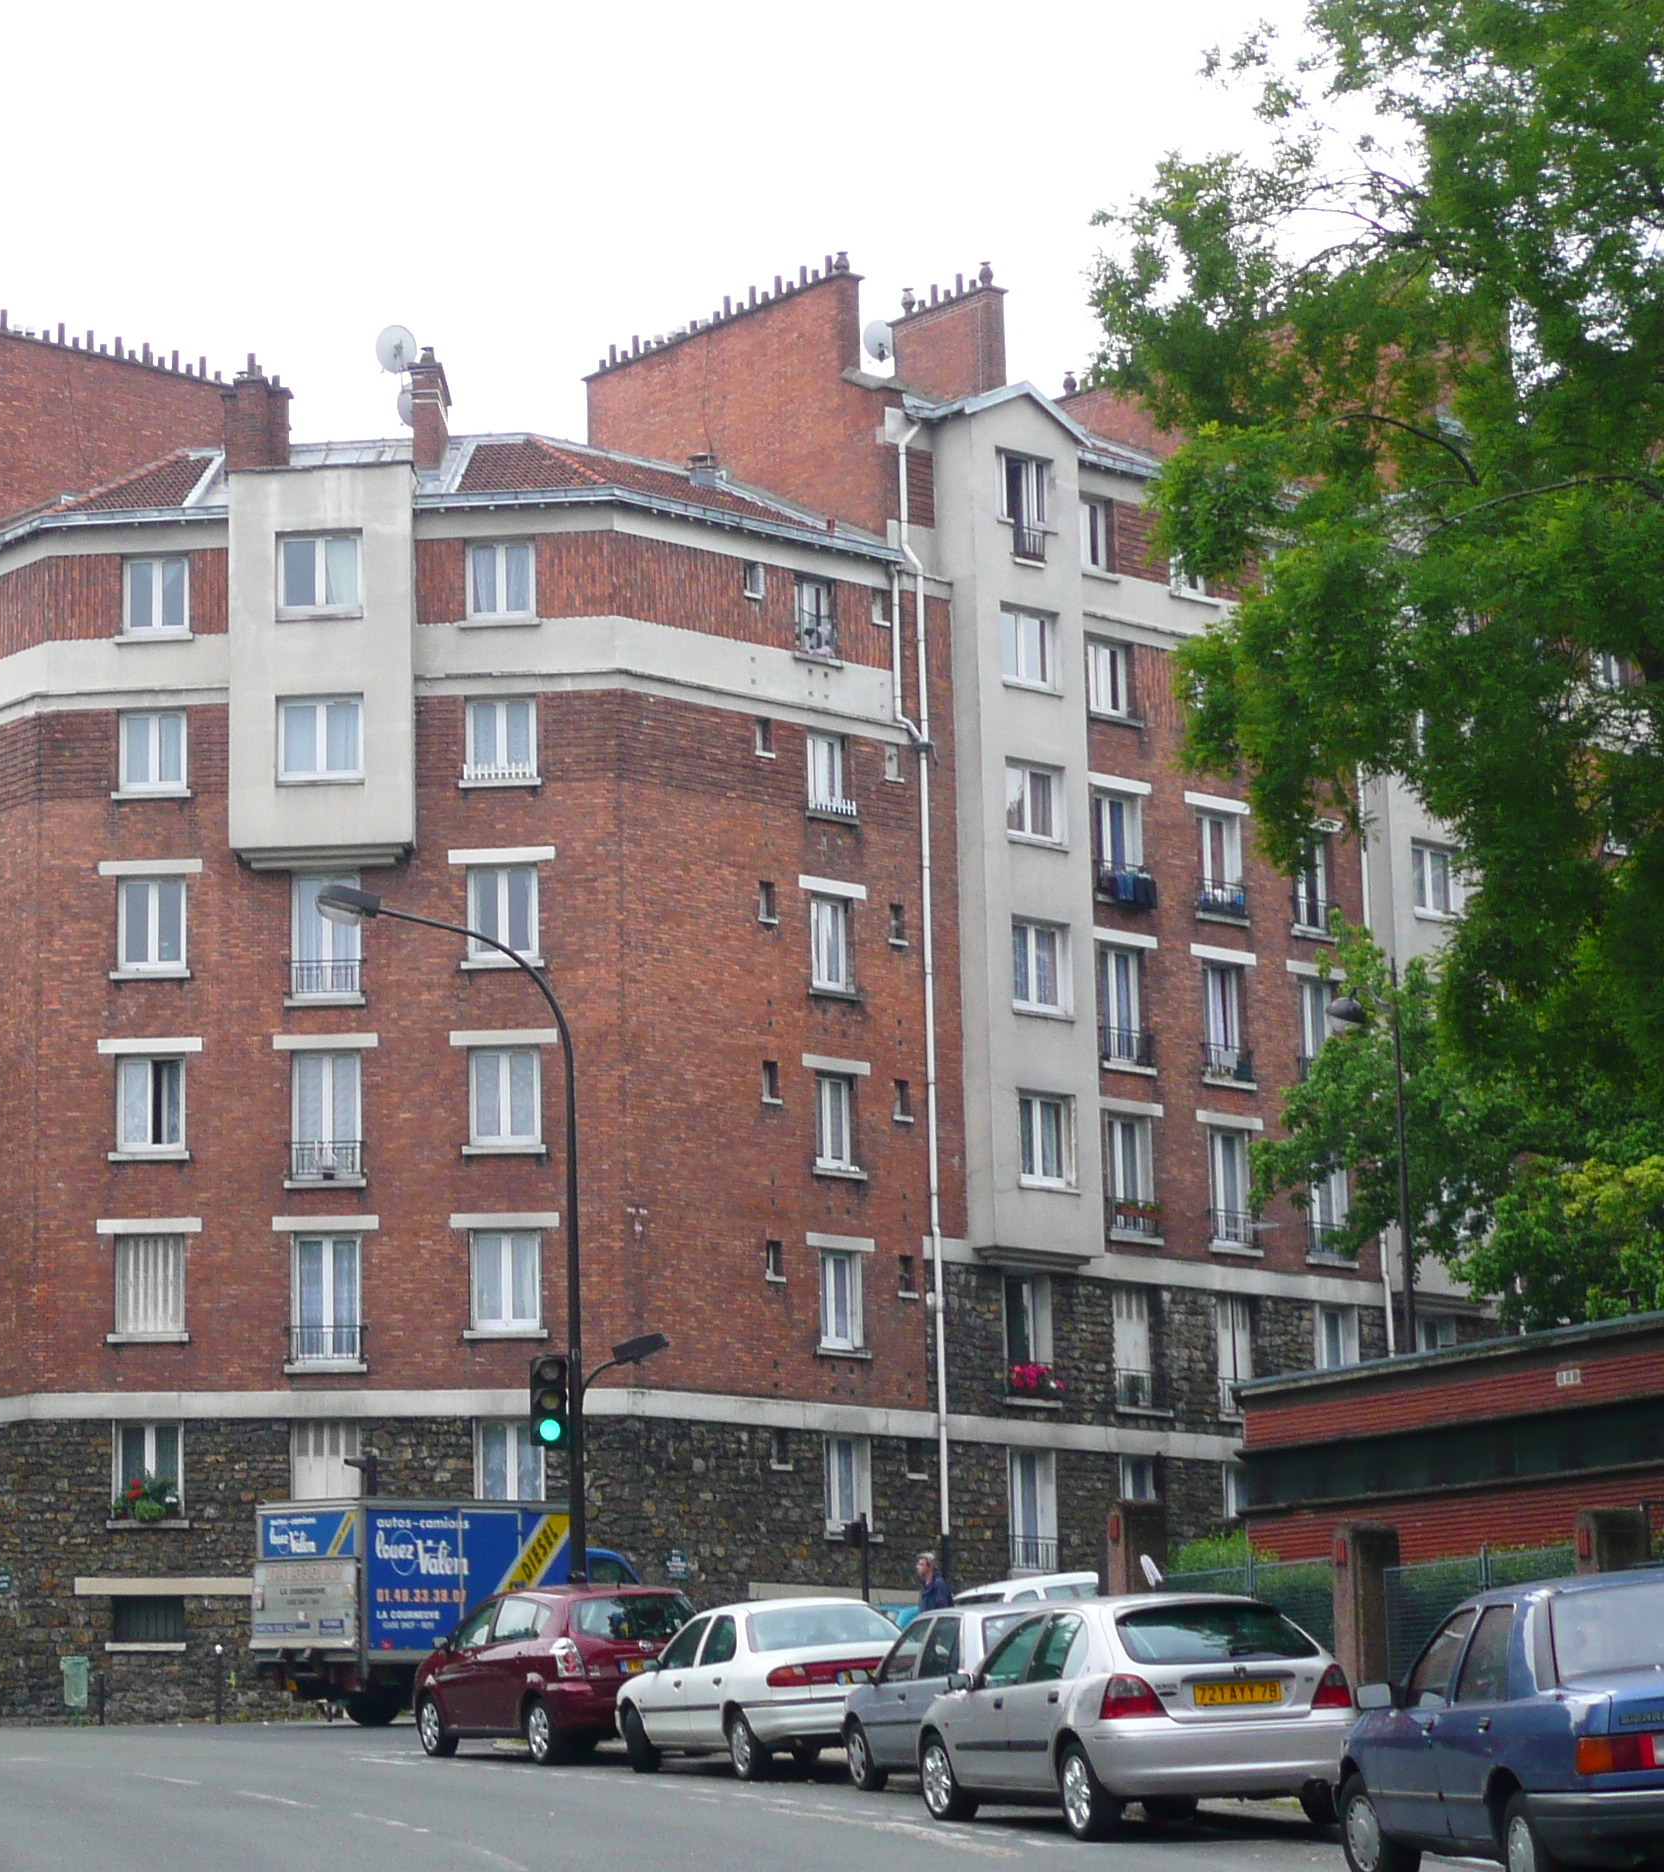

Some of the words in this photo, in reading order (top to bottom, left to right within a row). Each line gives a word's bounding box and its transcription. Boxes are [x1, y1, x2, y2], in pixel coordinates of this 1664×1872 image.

[376, 1516, 471, 1530] autos-camions
[375, 1530, 415, 1560] louez
[415, 1539, 470, 1575] Valem
[520, 1523, 559, 1582] DIESEL
[376, 1610, 388, 1619] LA
[1197, 1686, 1224, 1702] 721
[1230, 1684, 1255, 1700] AYY
